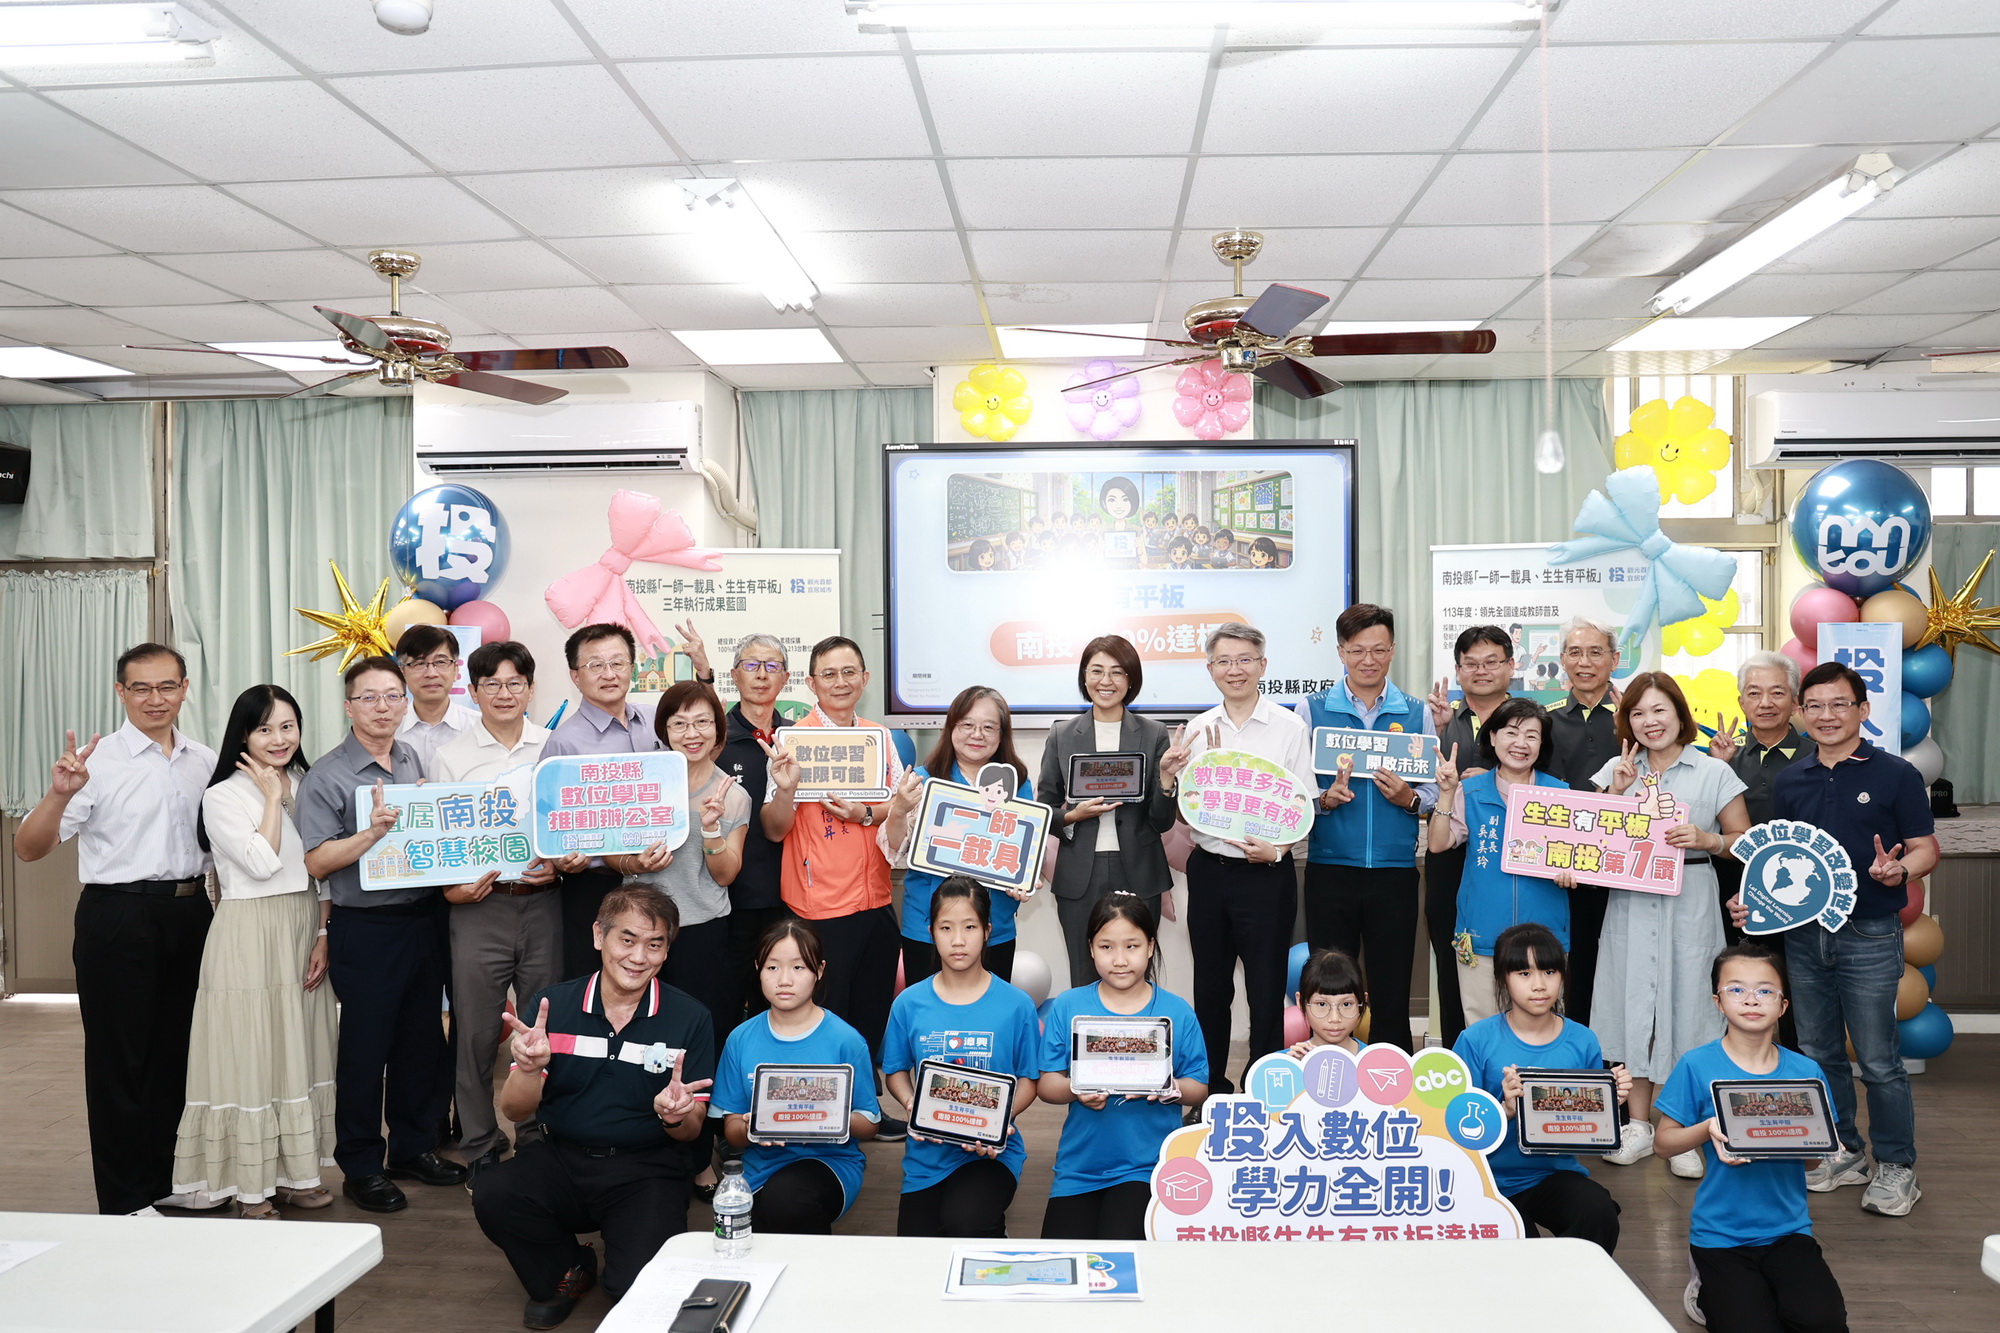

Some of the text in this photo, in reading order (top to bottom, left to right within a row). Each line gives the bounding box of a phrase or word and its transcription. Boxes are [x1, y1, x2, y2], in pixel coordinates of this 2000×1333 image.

[416, 502, 497, 584] 投
[1442, 568, 1602, 586] 南投縣「一師一載具、生生有平板」
[662, 596, 747, 612] 三年執行成果藍圖
[795, 745, 865, 763] 數位學習
[1325, 732, 1389, 753] 數位學習
[580, 761, 643, 782] 南投縣
[799, 766, 866, 784] 無限可能
[1365, 754, 1430, 775] 開啟未來
[1194, 765, 1293, 799] 教學更多元
[560, 783, 660, 807] 數位學習
[548, 806, 673, 831] 推動辦公室
[953, 808, 1019, 838] 一師
[1203, 790, 1303, 831] 學習更有效
[1522, 801, 1651, 840] 生生有平板
[405, 834, 531, 870] 智慧校園
[931, 836, 1020, 875] 一載具
[1545, 840, 1677, 882] 南投第1讚
[1748, 883, 1757, 893] Let
[1757, 889, 1773, 906] Digital
[1415, 1069, 1462, 1092] abc
[1208, 1101, 1420, 1157] 投入數位
[1231, 1165, 1451, 1212] 學力全開!
